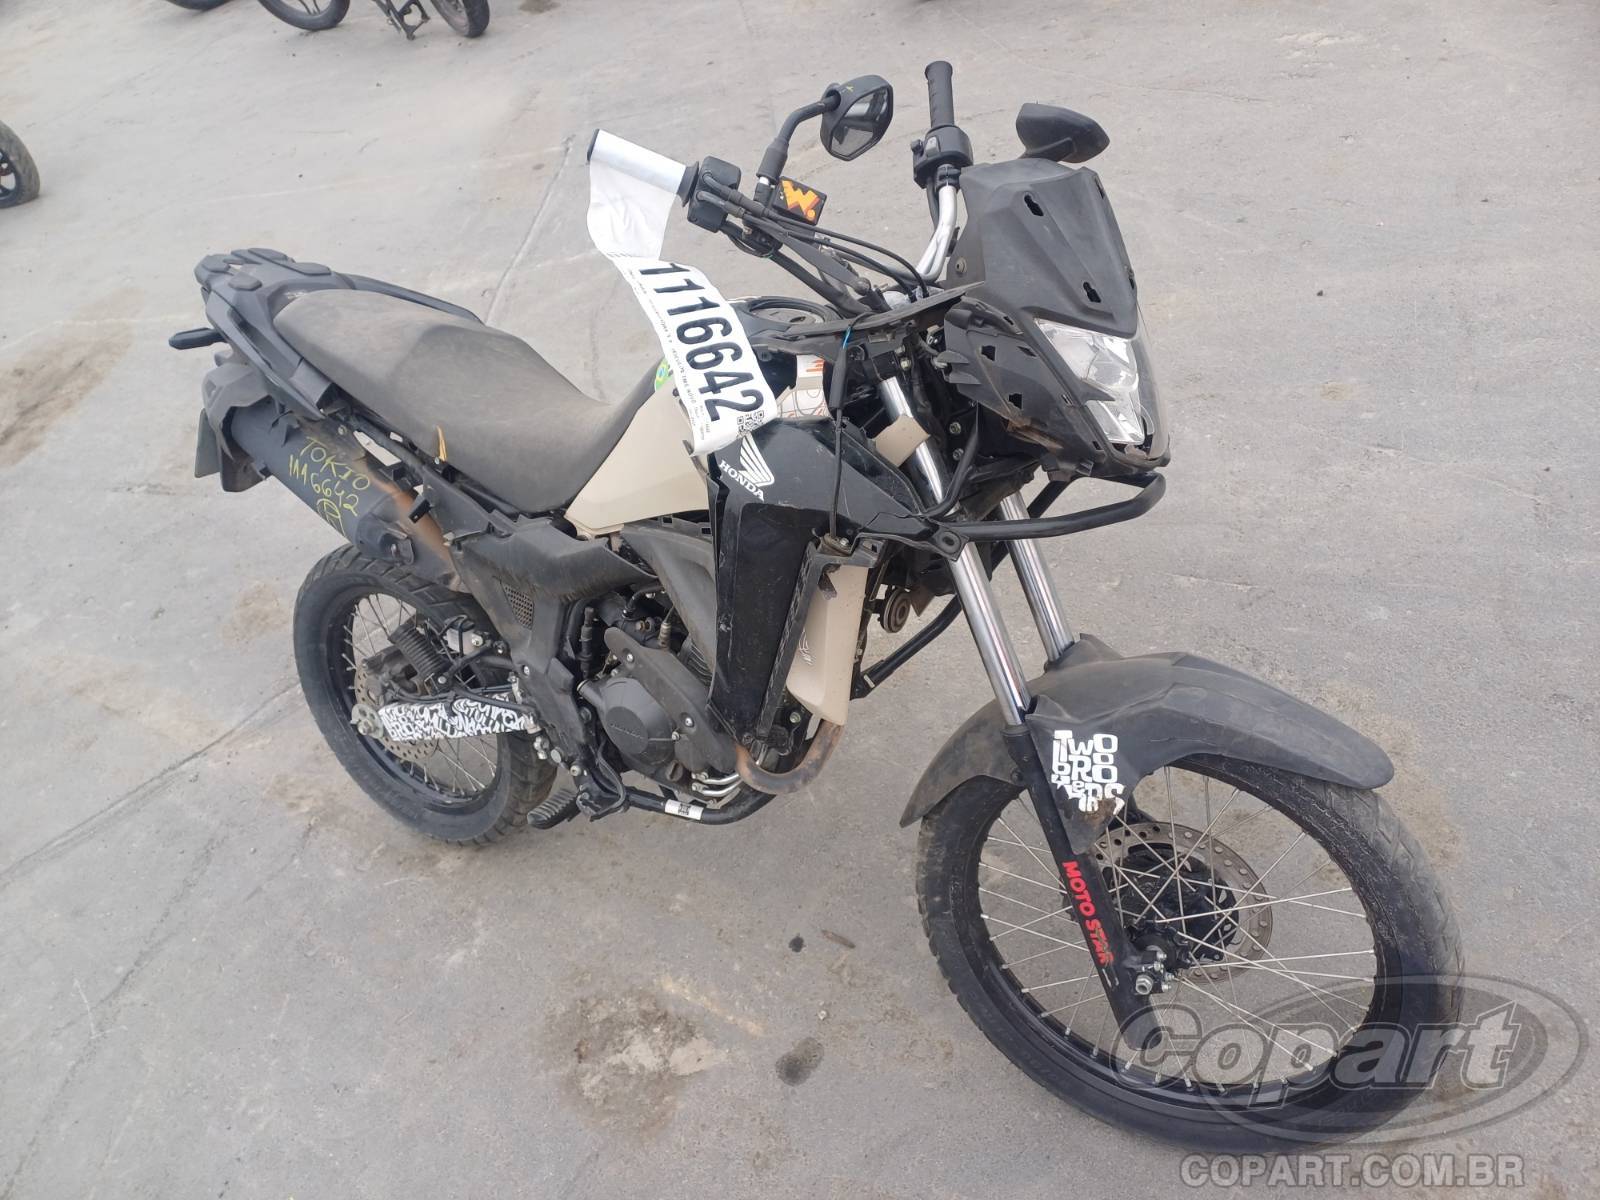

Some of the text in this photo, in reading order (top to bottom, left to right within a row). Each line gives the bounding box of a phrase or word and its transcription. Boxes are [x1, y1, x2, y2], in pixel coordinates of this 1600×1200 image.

[639, 262, 764, 421] 1116642
[300, 436, 371, 490] TOKIO
[719, 460, 765, 502] HONDA
[1062, 860, 1096, 917] MOTO
